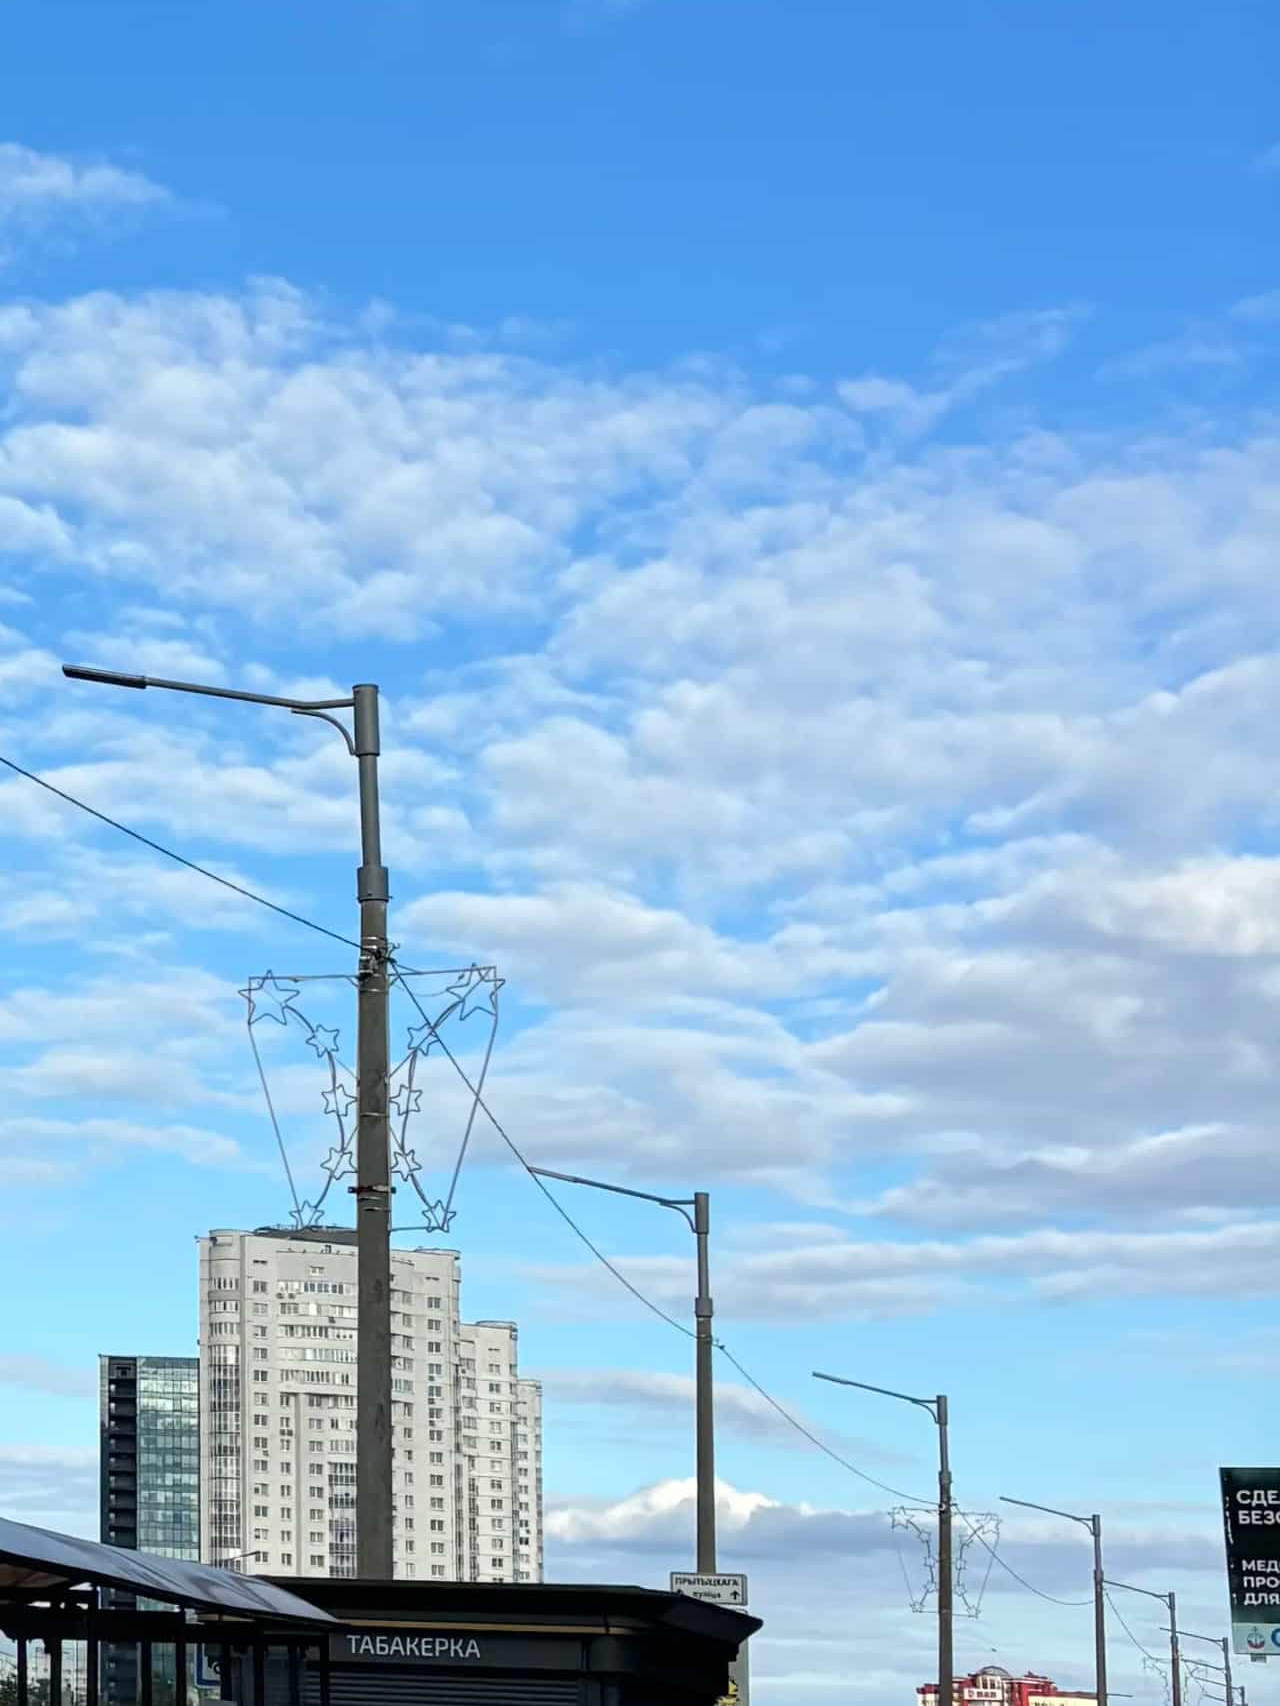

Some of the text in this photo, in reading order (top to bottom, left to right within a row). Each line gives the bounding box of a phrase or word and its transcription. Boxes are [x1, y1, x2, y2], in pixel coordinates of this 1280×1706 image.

[1236, 1490, 1280, 1507] СДЕ
[1242, 1559, 1280, 1573] МЕД
[1243, 1576, 1280, 1588] ПРО
[1244, 1592, 1280, 1606] ДЛЯ
[346, 1634, 481, 1659] ТАБАКЕРКА
